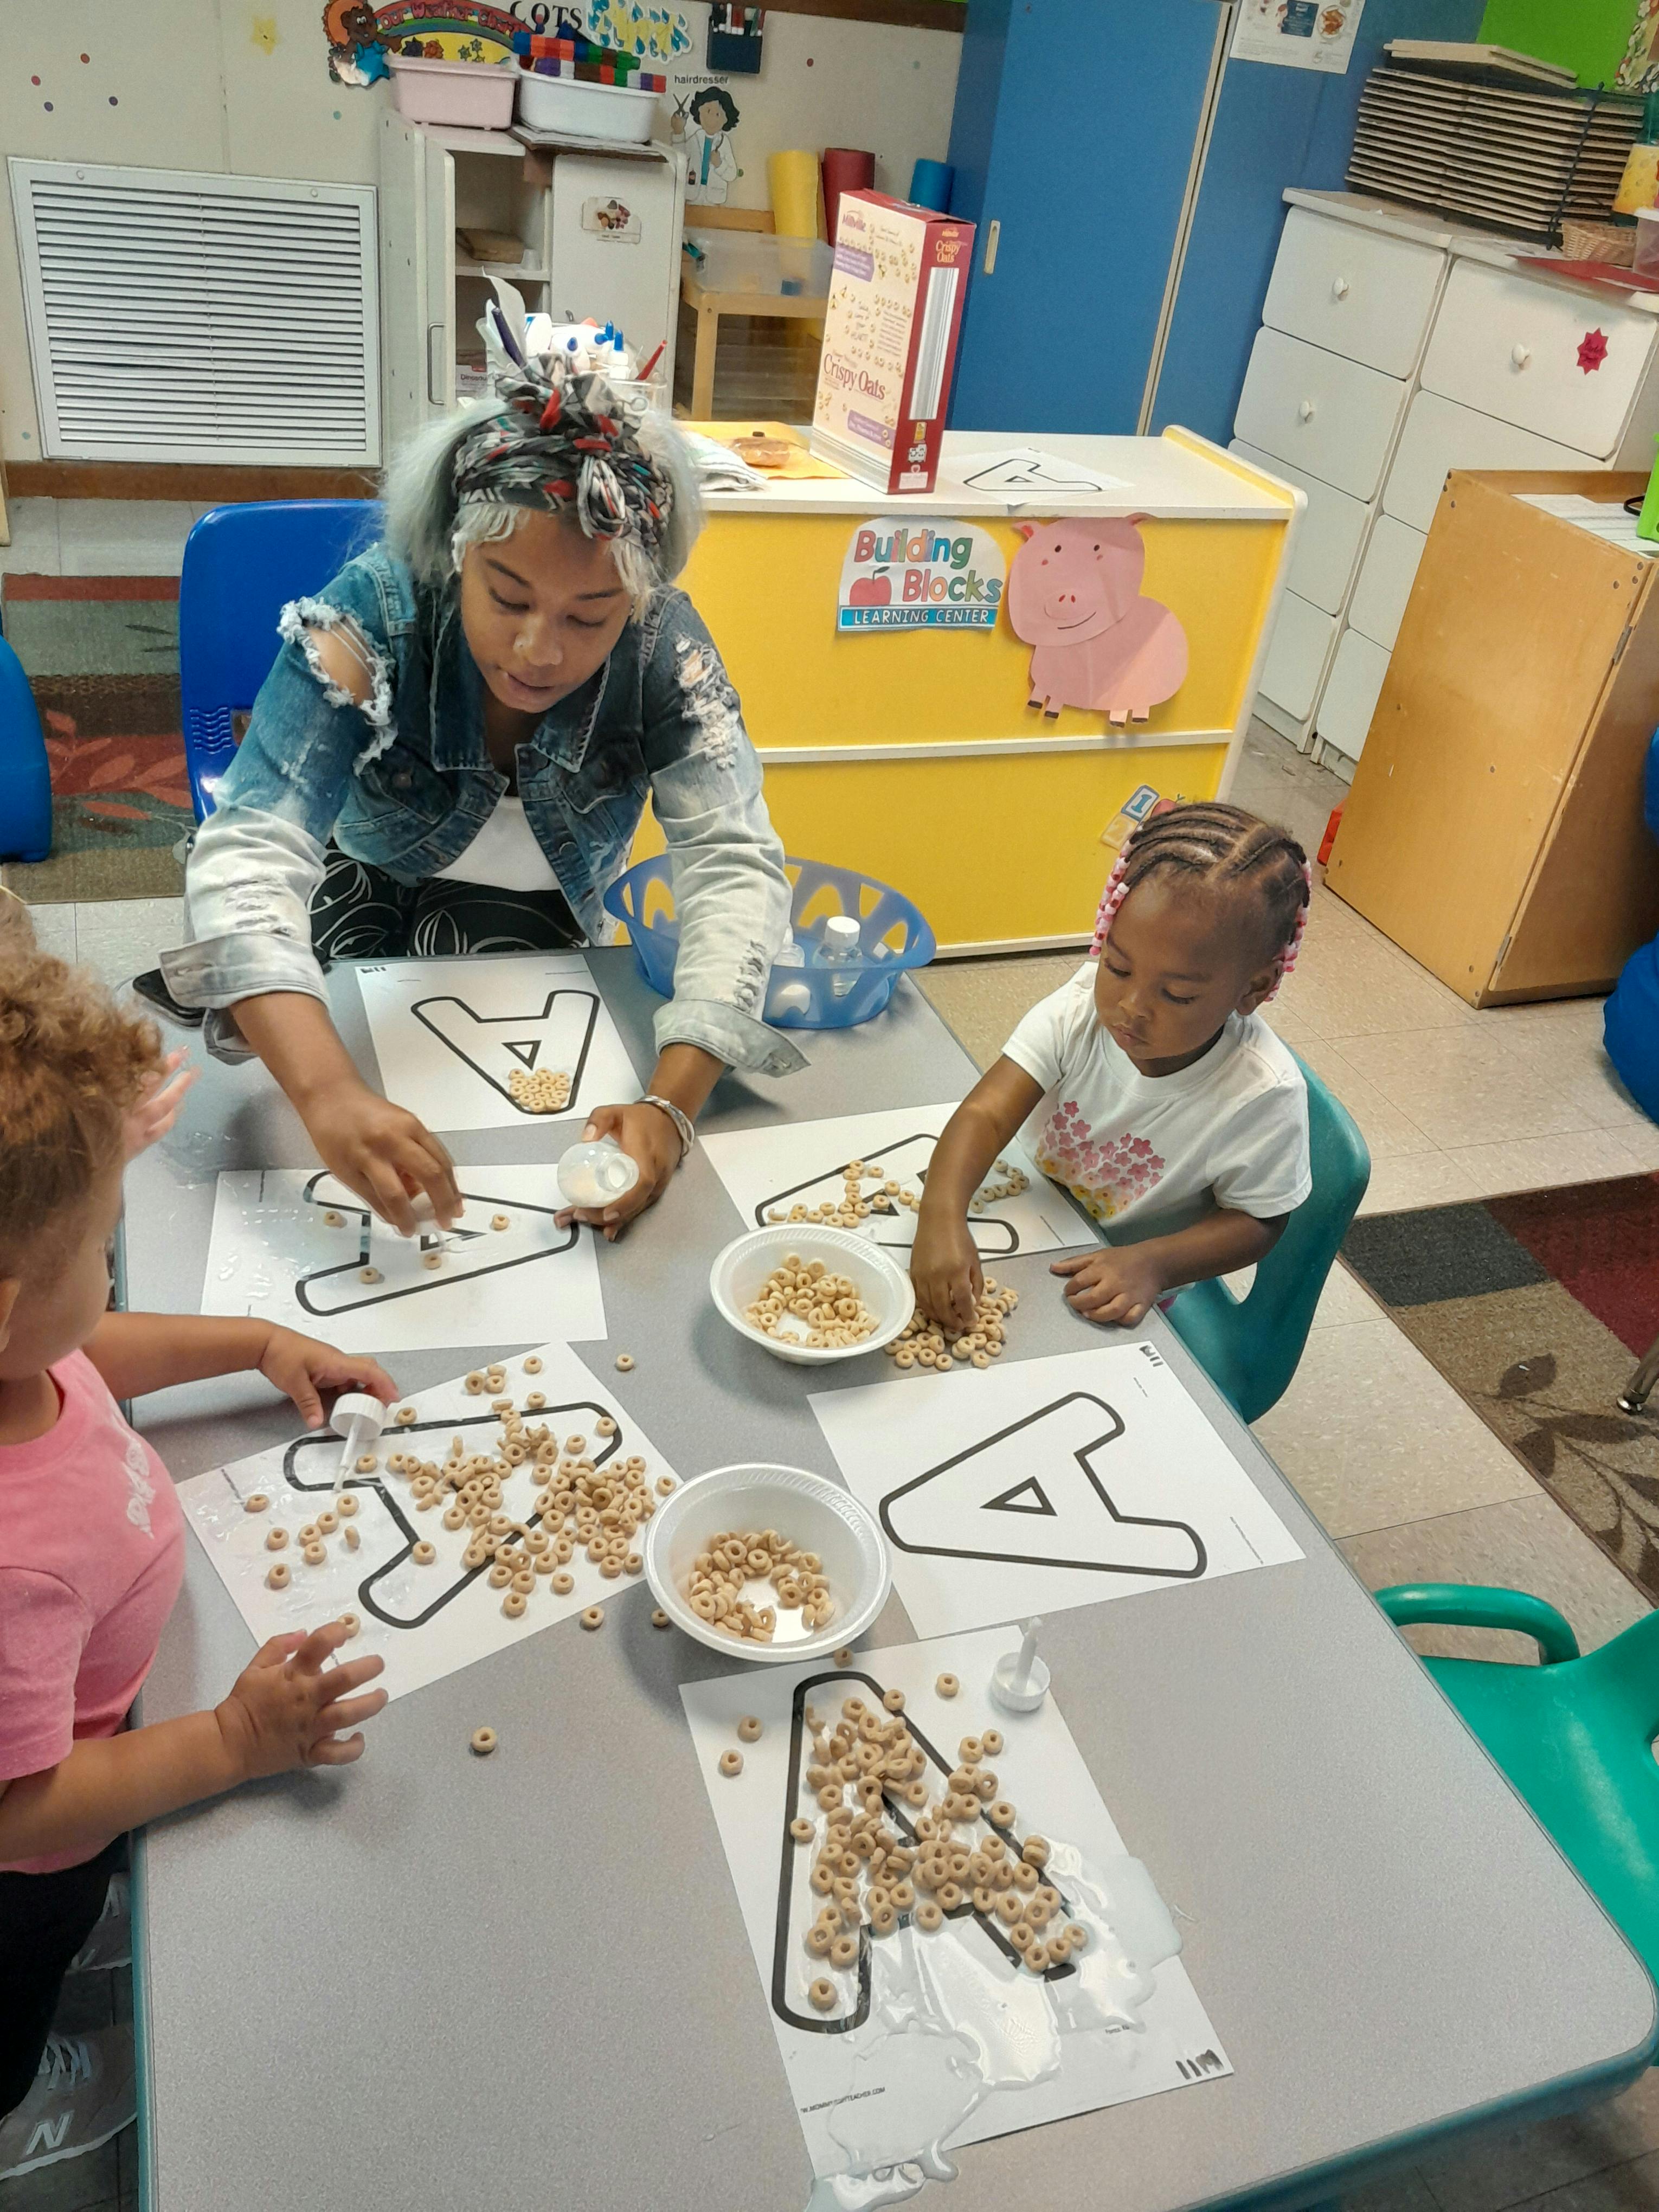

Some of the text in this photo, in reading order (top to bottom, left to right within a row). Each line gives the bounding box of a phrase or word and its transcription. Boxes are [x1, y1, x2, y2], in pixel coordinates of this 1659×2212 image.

[674, 75, 729, 84] hairdresser
[936, 240, 961, 255] Crispy
[937, 252, 955, 263] Oats
[824, 353, 857, 391] Crispy
[858, 370, 885, 400] Oats
[854, 529, 973, 569] Building
[902, 569, 1003, 603] Blocks
[854, 608, 989, 624] LEARNING CENTER
[26, 2111, 73, 2156] N
